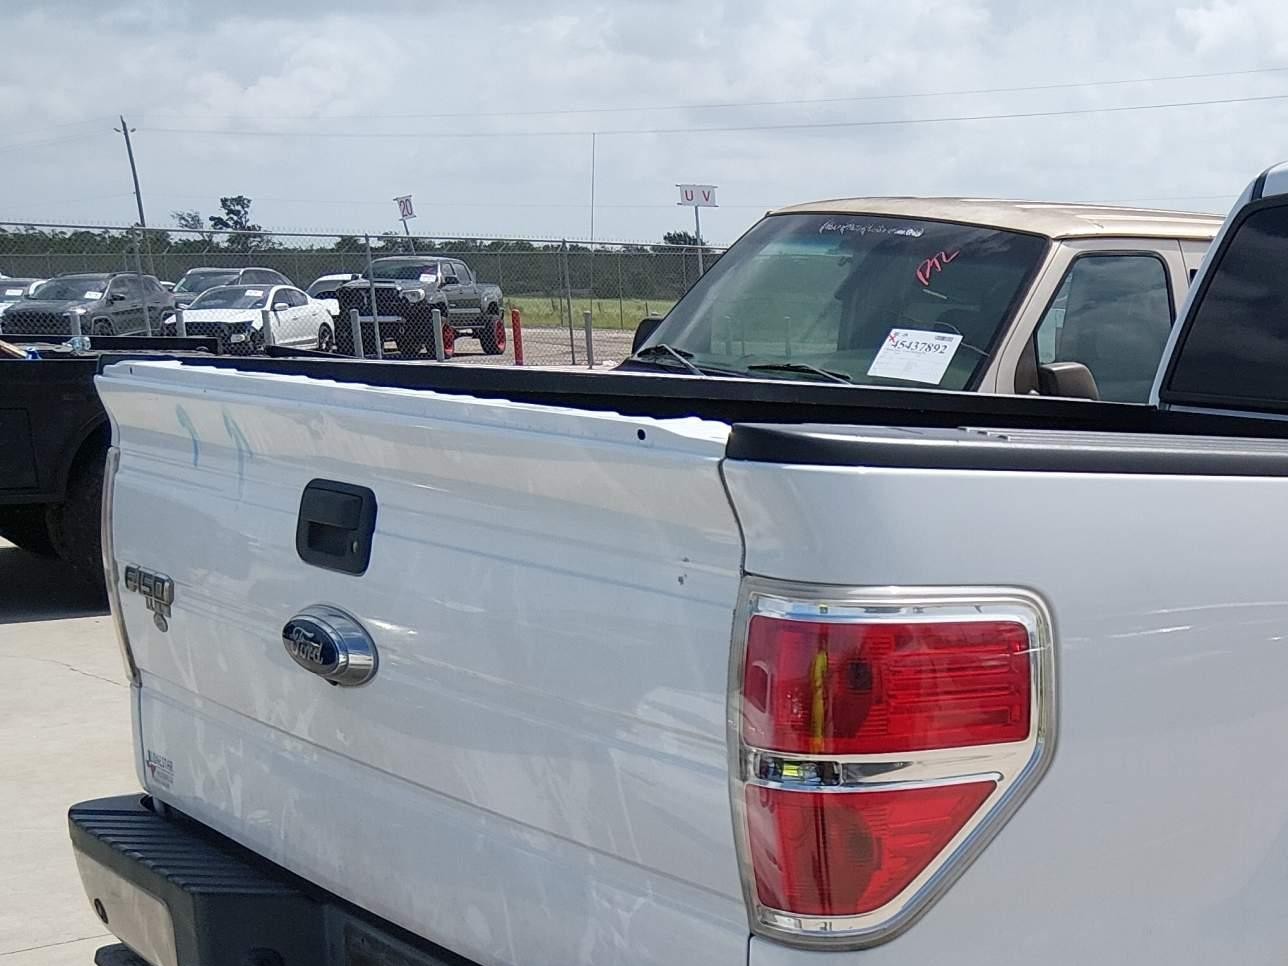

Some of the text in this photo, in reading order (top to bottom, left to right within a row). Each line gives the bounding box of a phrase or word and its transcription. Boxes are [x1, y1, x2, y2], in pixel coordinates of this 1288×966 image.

[684, 189, 711, 202] U V
[399, 198, 413, 218] 20
[891, 339, 948, 354] 45437892
[290, 626, 325, 665] Ford
